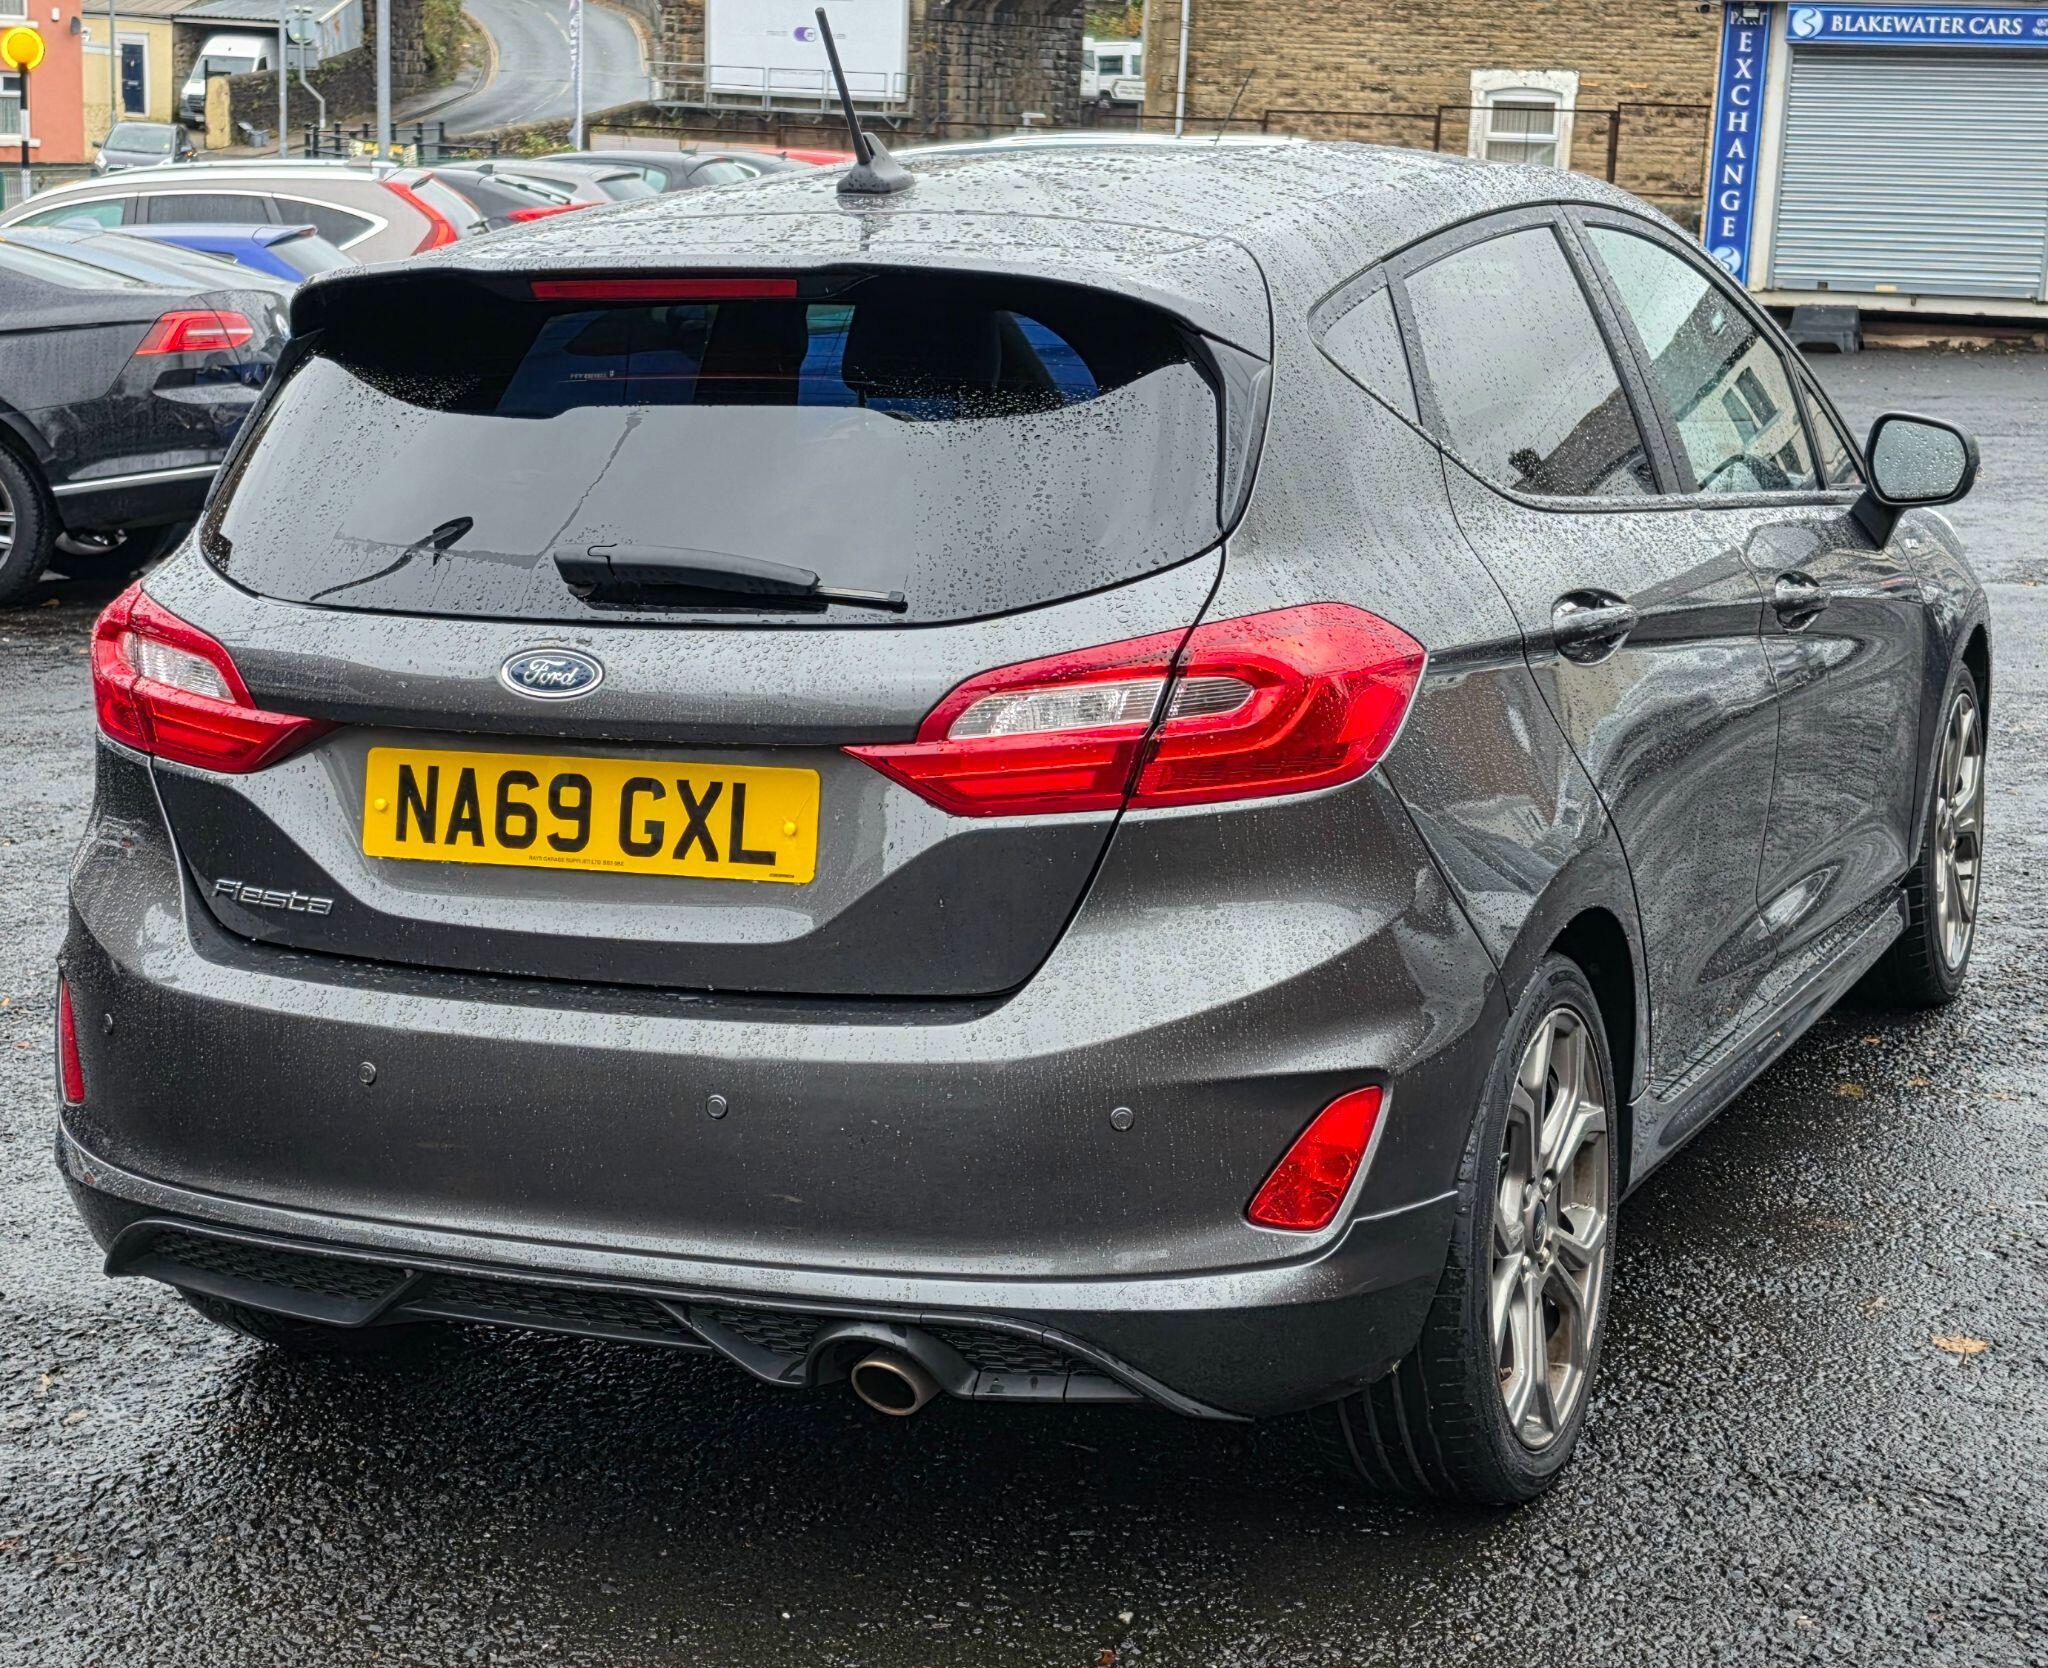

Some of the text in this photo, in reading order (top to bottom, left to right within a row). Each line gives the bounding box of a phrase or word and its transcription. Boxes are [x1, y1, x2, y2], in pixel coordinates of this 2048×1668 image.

[1730, 11, 1767, 25] PAT
[1831, 15, 1966, 34] BLAKEWATER
[1969, 17, 2023, 35] CARS
[1720, 31, 1753, 237] EXCHANGE
[524, 659, 580, 685] Ford
[395, 764, 777, 867] NA69 GXL
[211, 879, 334, 915] Fiesta
